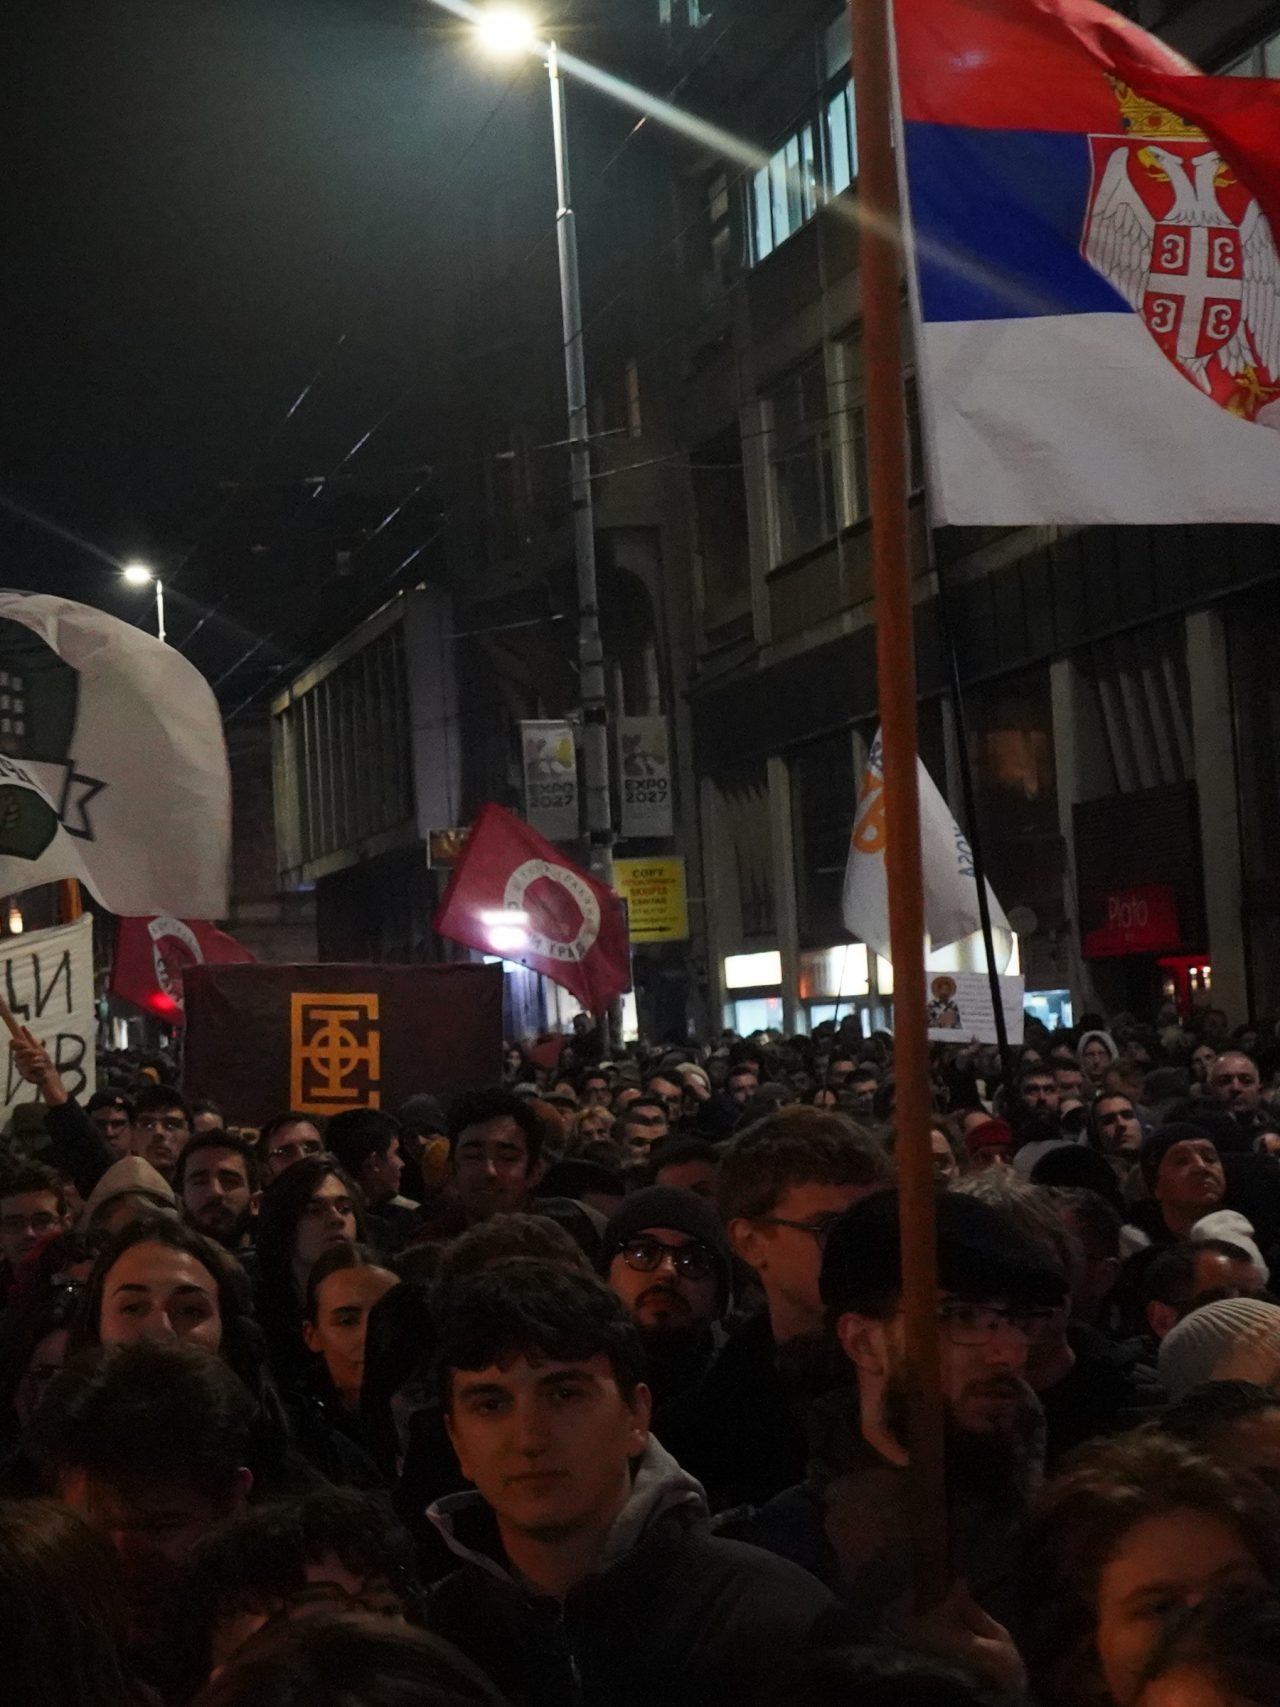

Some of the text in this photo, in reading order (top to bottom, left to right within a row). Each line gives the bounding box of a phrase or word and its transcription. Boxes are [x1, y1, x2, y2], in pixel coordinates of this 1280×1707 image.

[528, 782, 574, 794] EXPO
[625, 778, 668, 791] EXPO
[529, 795, 574, 808] 2027
[625, 791, 668, 803] 2027
